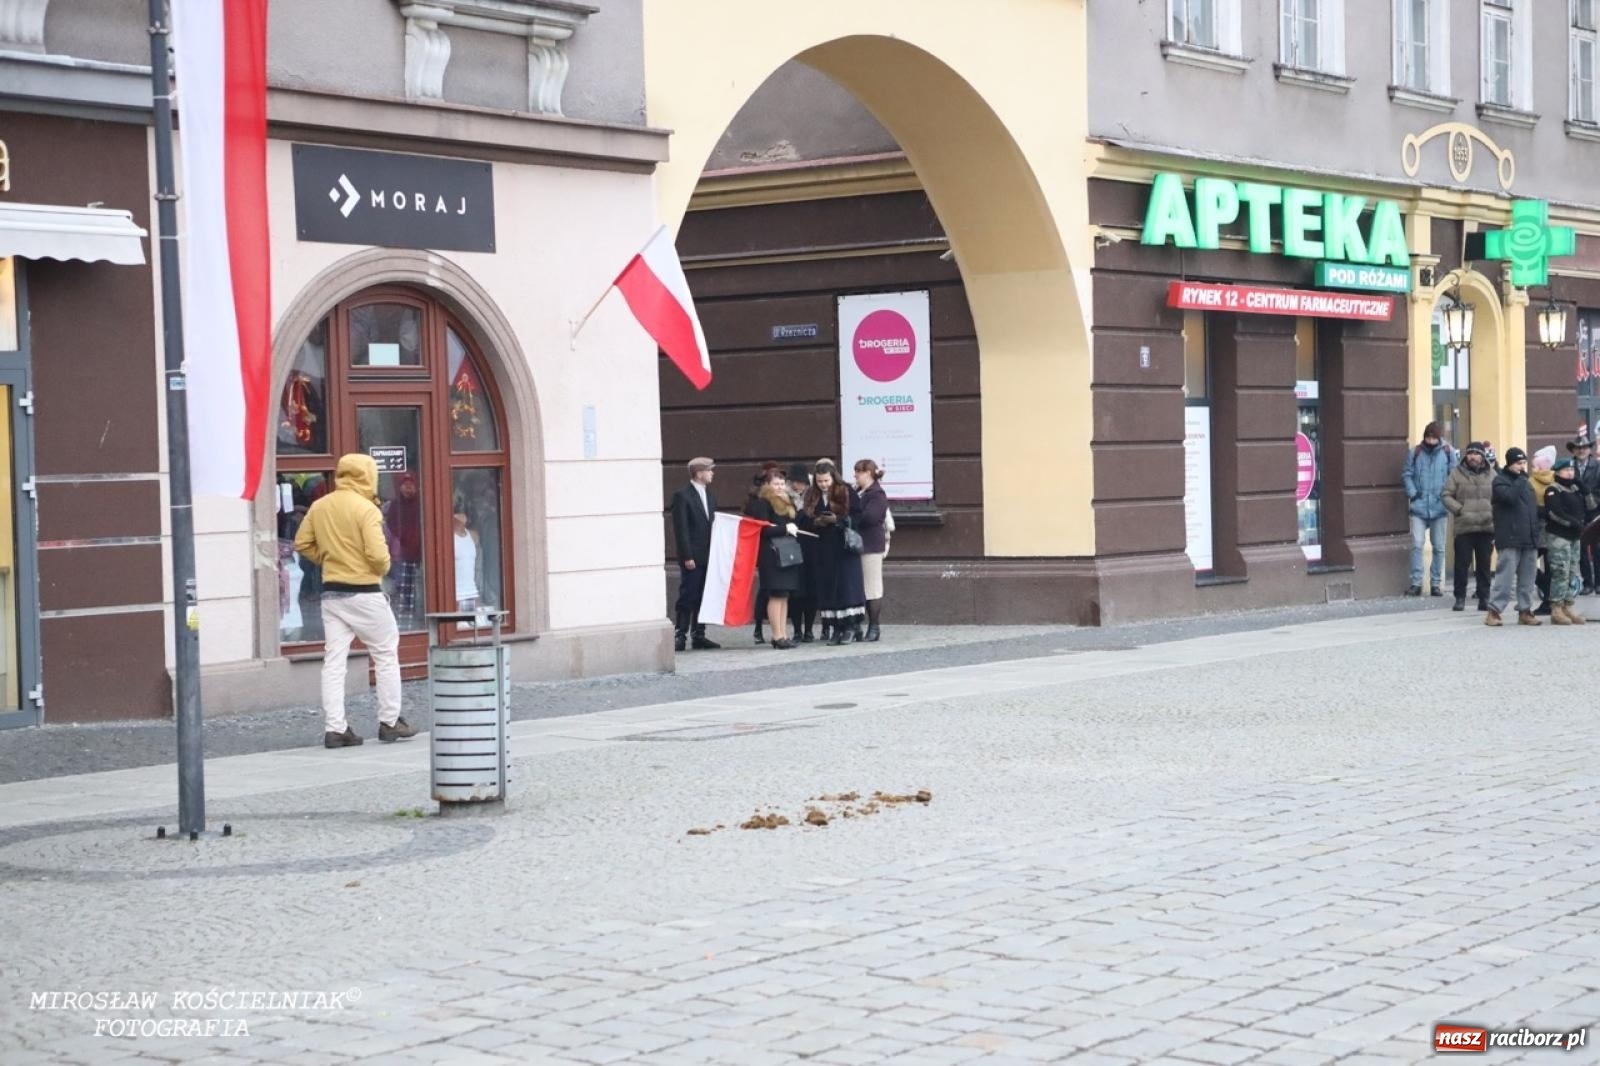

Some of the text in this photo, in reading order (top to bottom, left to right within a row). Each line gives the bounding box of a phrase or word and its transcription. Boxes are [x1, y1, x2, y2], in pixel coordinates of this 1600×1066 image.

[370, 188, 468, 216] MORAJ
[1140, 172, 1411, 267] APTEKA
[1328, 268, 1408, 289] POD RÓŻAMI
[1182, 289, 1222, 306] RYNEK
[1225, 291, 1239, 306] 12
[1246, 292, 1299, 311] CENTRUM
[1300, 295, 1390, 317] FARMACEUTYCZNE
[859, 338, 909, 349] DROGERIA
[858, 395, 913, 406] DROGERIA
